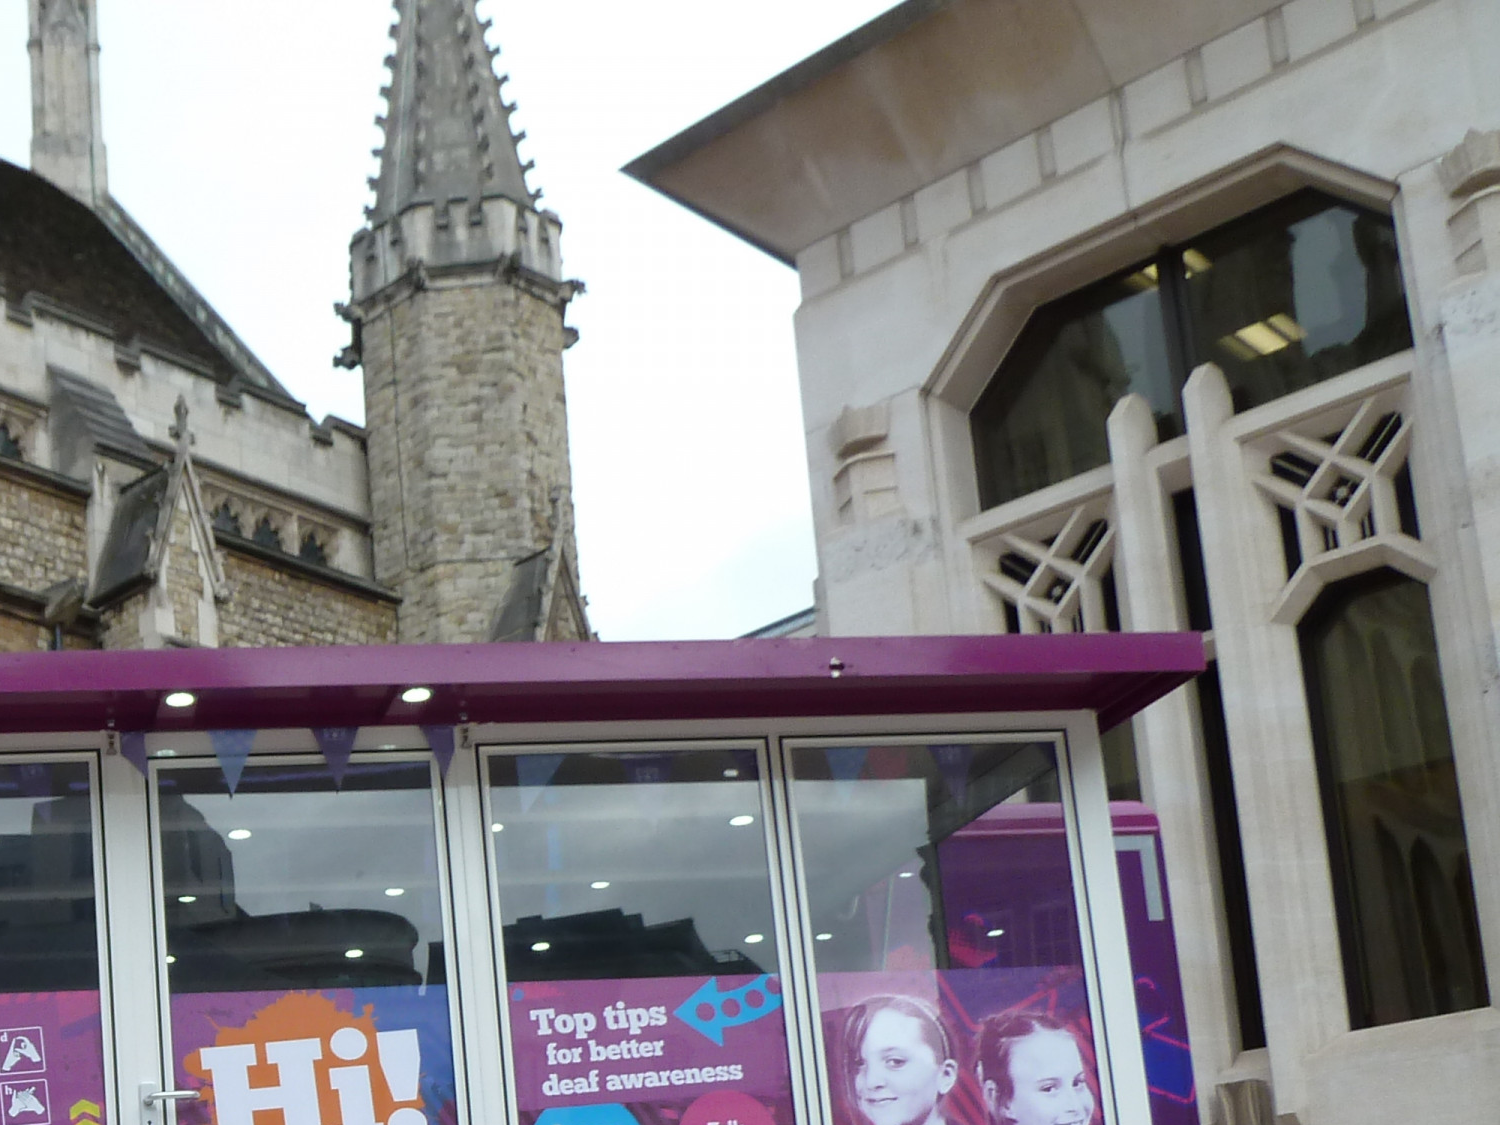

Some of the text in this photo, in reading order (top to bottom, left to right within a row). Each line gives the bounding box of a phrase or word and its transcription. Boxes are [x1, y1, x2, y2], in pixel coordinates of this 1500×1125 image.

[530, 1001, 668, 1039] Top tips
[546, 1039, 665, 1065] for better
[542, 1064, 744, 1096] deaf awareness
